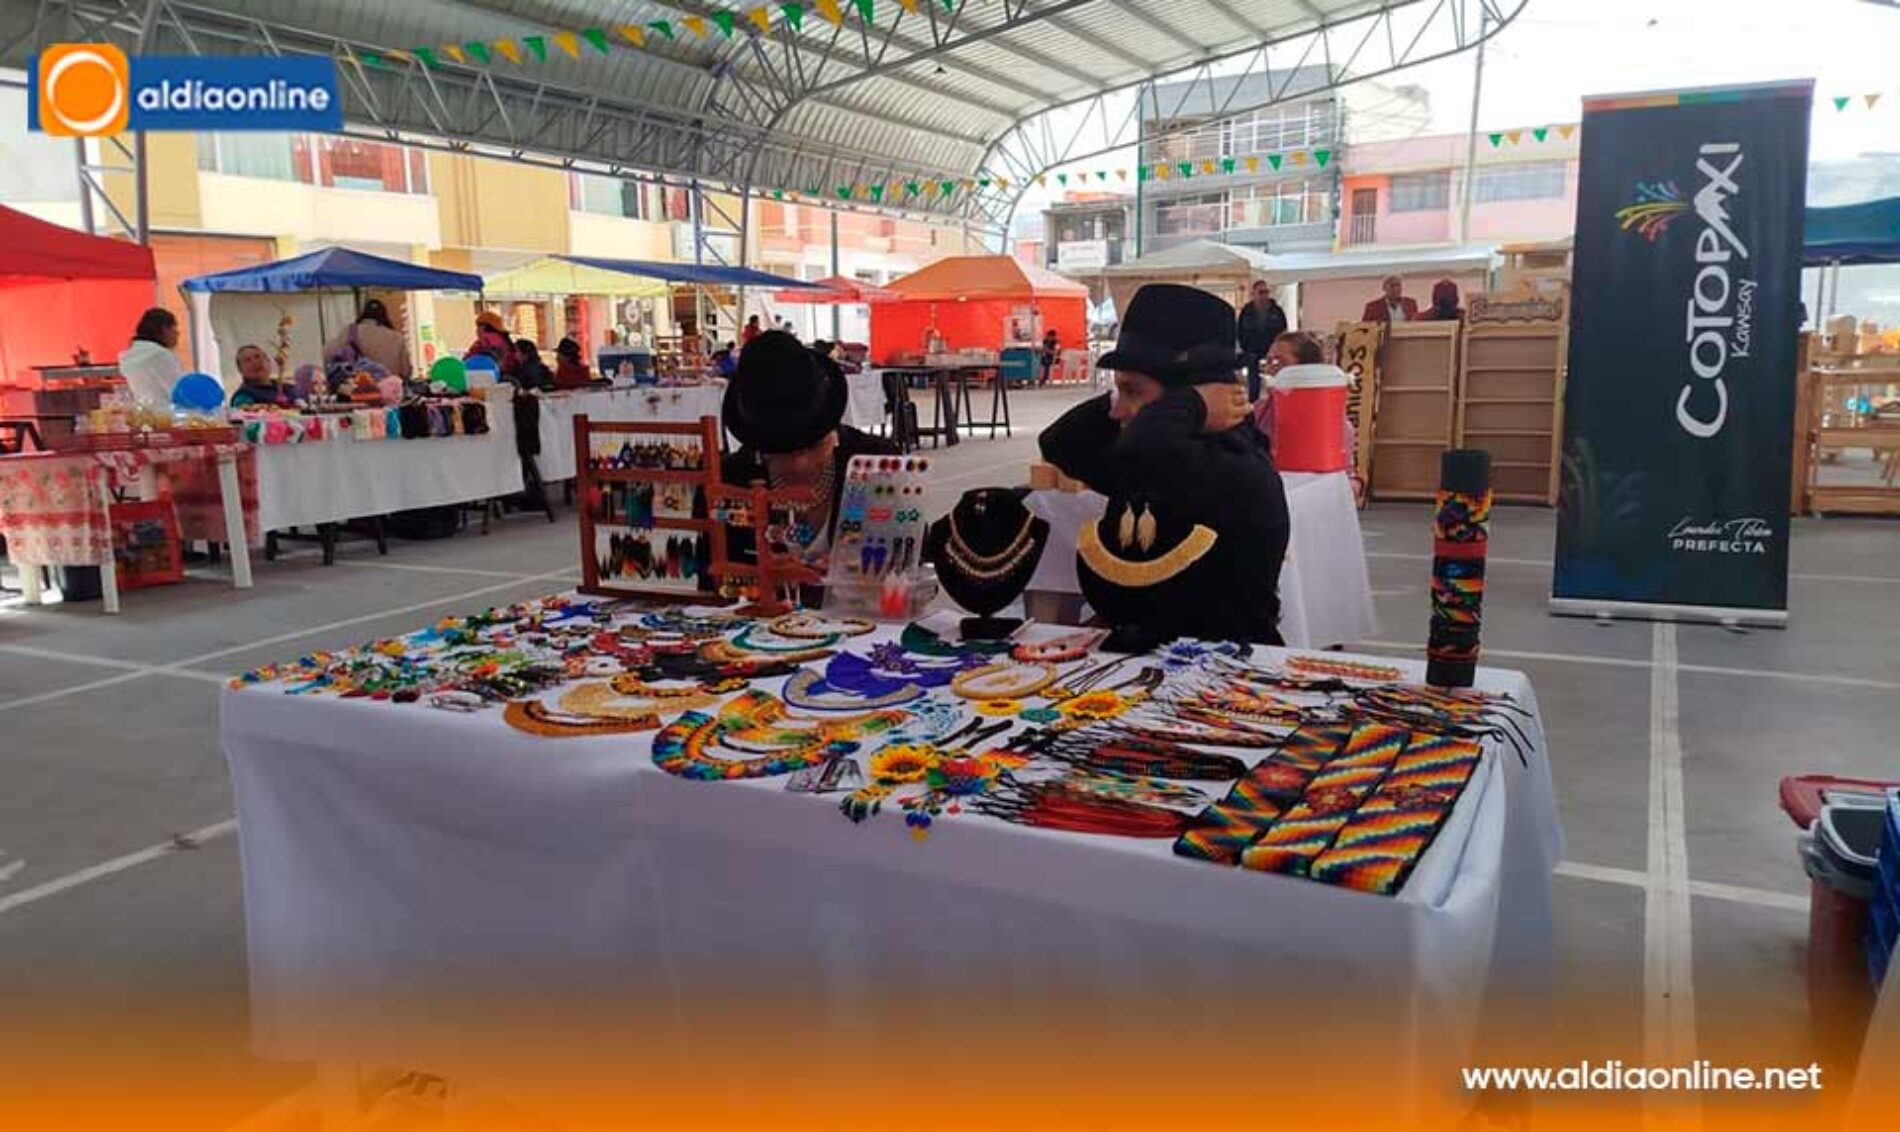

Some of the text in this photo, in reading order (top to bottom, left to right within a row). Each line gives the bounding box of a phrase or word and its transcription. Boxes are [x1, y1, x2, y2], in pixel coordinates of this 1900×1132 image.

[1676, 142, 1749, 438] COTOPAXI
[1731, 278, 1758, 358] Kawsay
[1672, 539, 1765, 553] PREFECTA
